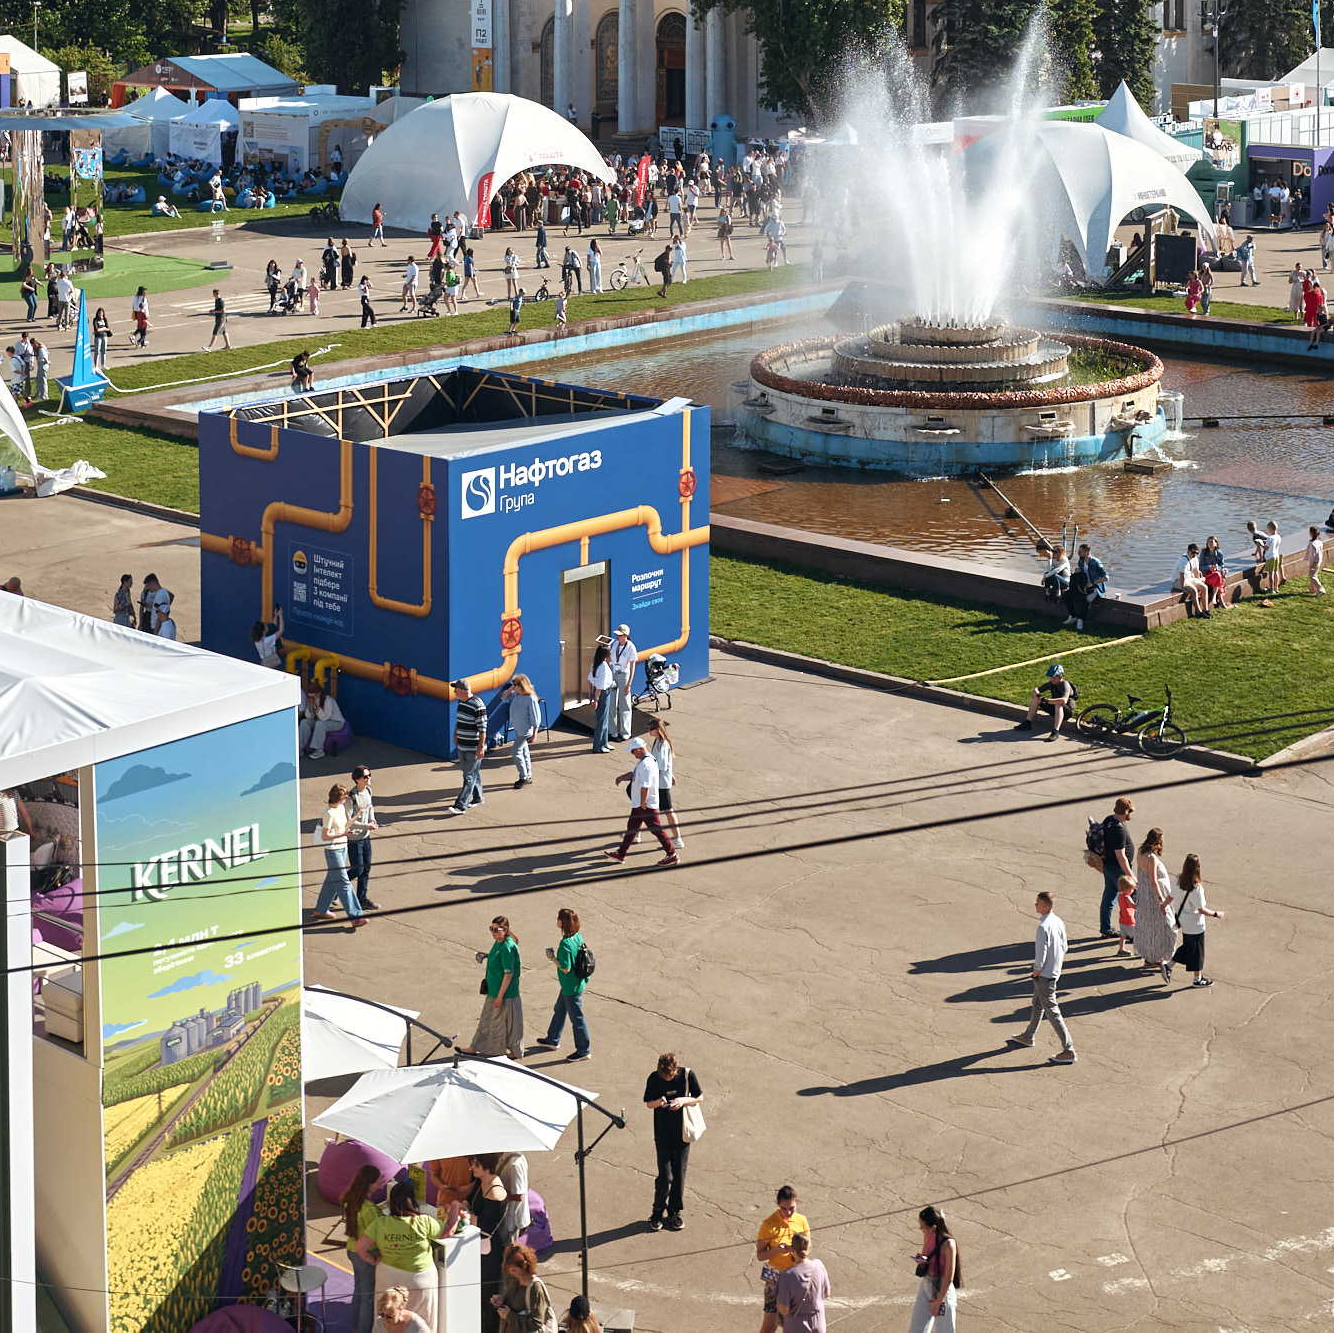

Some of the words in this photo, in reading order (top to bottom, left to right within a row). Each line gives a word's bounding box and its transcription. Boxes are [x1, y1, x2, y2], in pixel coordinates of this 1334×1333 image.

[475, 29, 487, 38] П2
[1292, 162, 1312, 177] Do
[499, 449, 603, 489] Нафтогаз
[499, 492, 535, 514] Група
[313, 553, 345, 569] Штучний
[313, 564, 343, 580] Інтелект
[631, 568, 664, 584] Розпочни
[313, 576, 341, 590] підбере
[631, 578, 663, 593] маршрут
[313, 586, 319, 595] 3
[319, 589, 349, 603] компанії
[313, 598, 324, 609] під
[325, 602, 341, 612] тебе
[131, 823, 270, 903] KERNEL
[224, 951, 245, 969] 33
